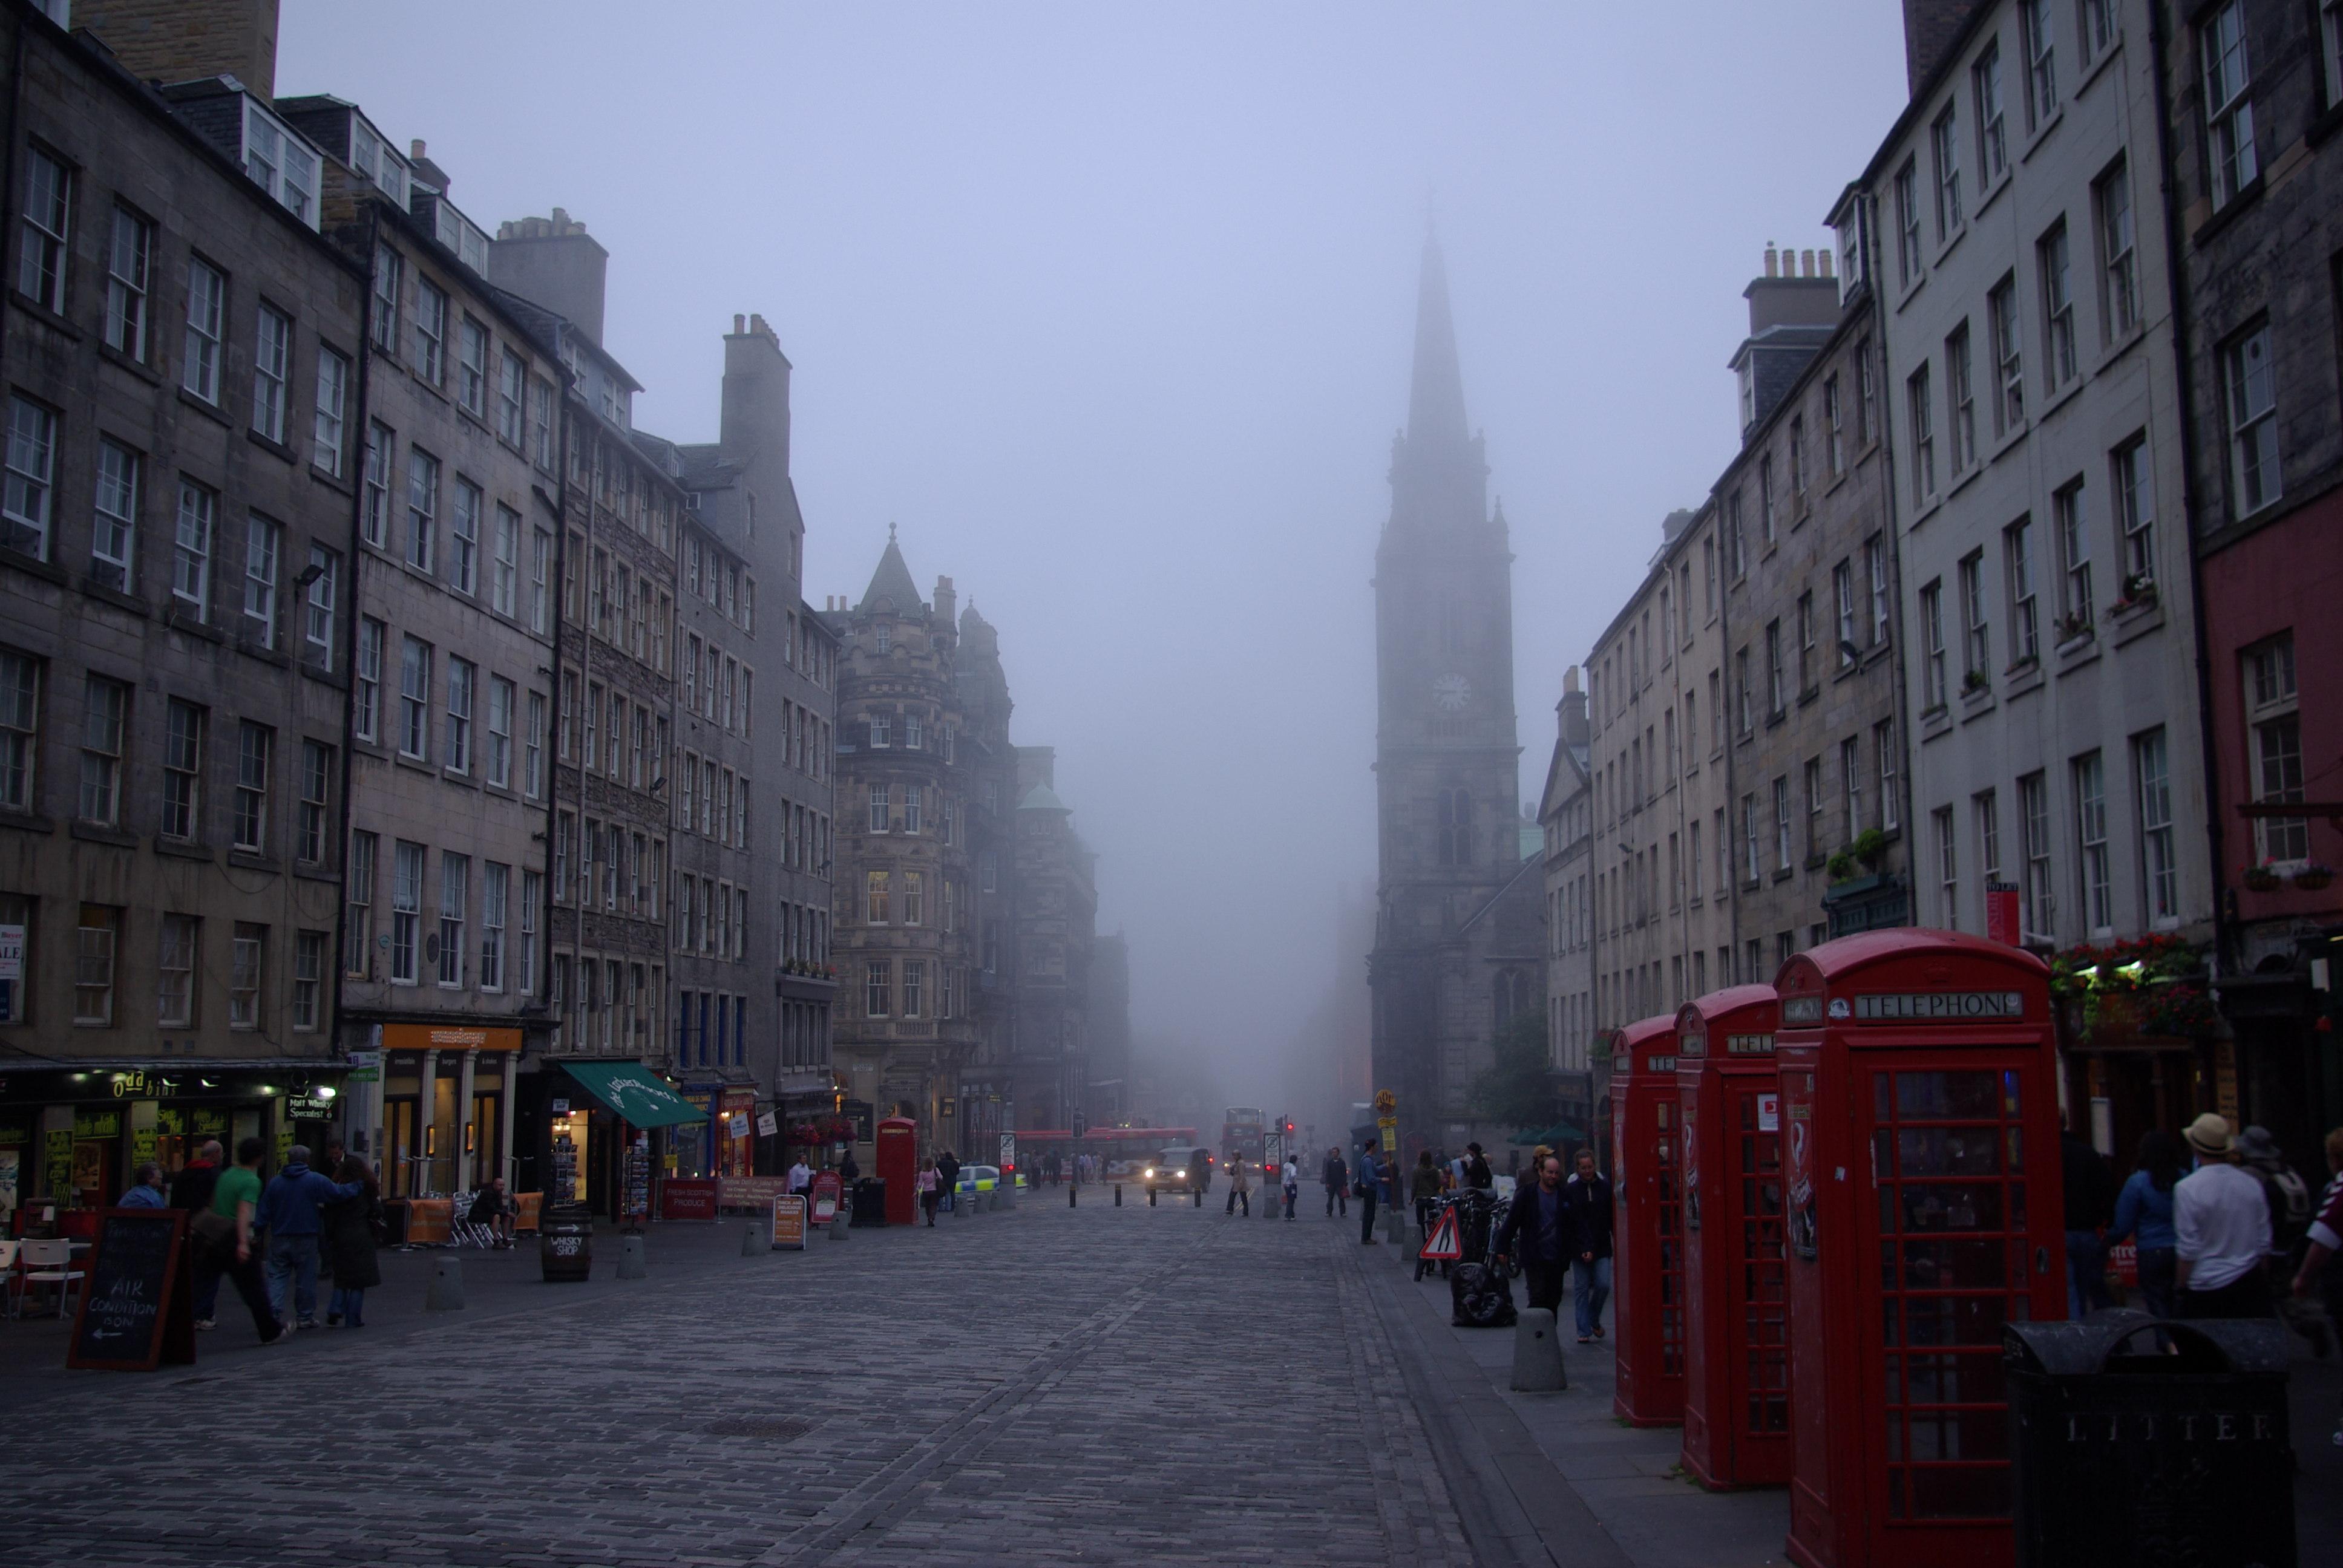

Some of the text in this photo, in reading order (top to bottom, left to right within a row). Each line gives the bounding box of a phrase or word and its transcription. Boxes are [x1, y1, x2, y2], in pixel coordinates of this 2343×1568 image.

[1862, 995, 2017, 1016] TELEPHONE
[289, 1099, 332, 1109] Malt Whisky
[289, 1108, 323, 1119] Specialist
[667, 1188, 687, 1197] FRESH
[673, 1198, 706, 1206] PRODUCE
[551, 1236, 582, 1246] WHISKY
[557, 1246, 578, 1256] SHOP
[111, 1275, 143, 1297] AIR
[2066, 1413, 2274, 1442] LITTER
